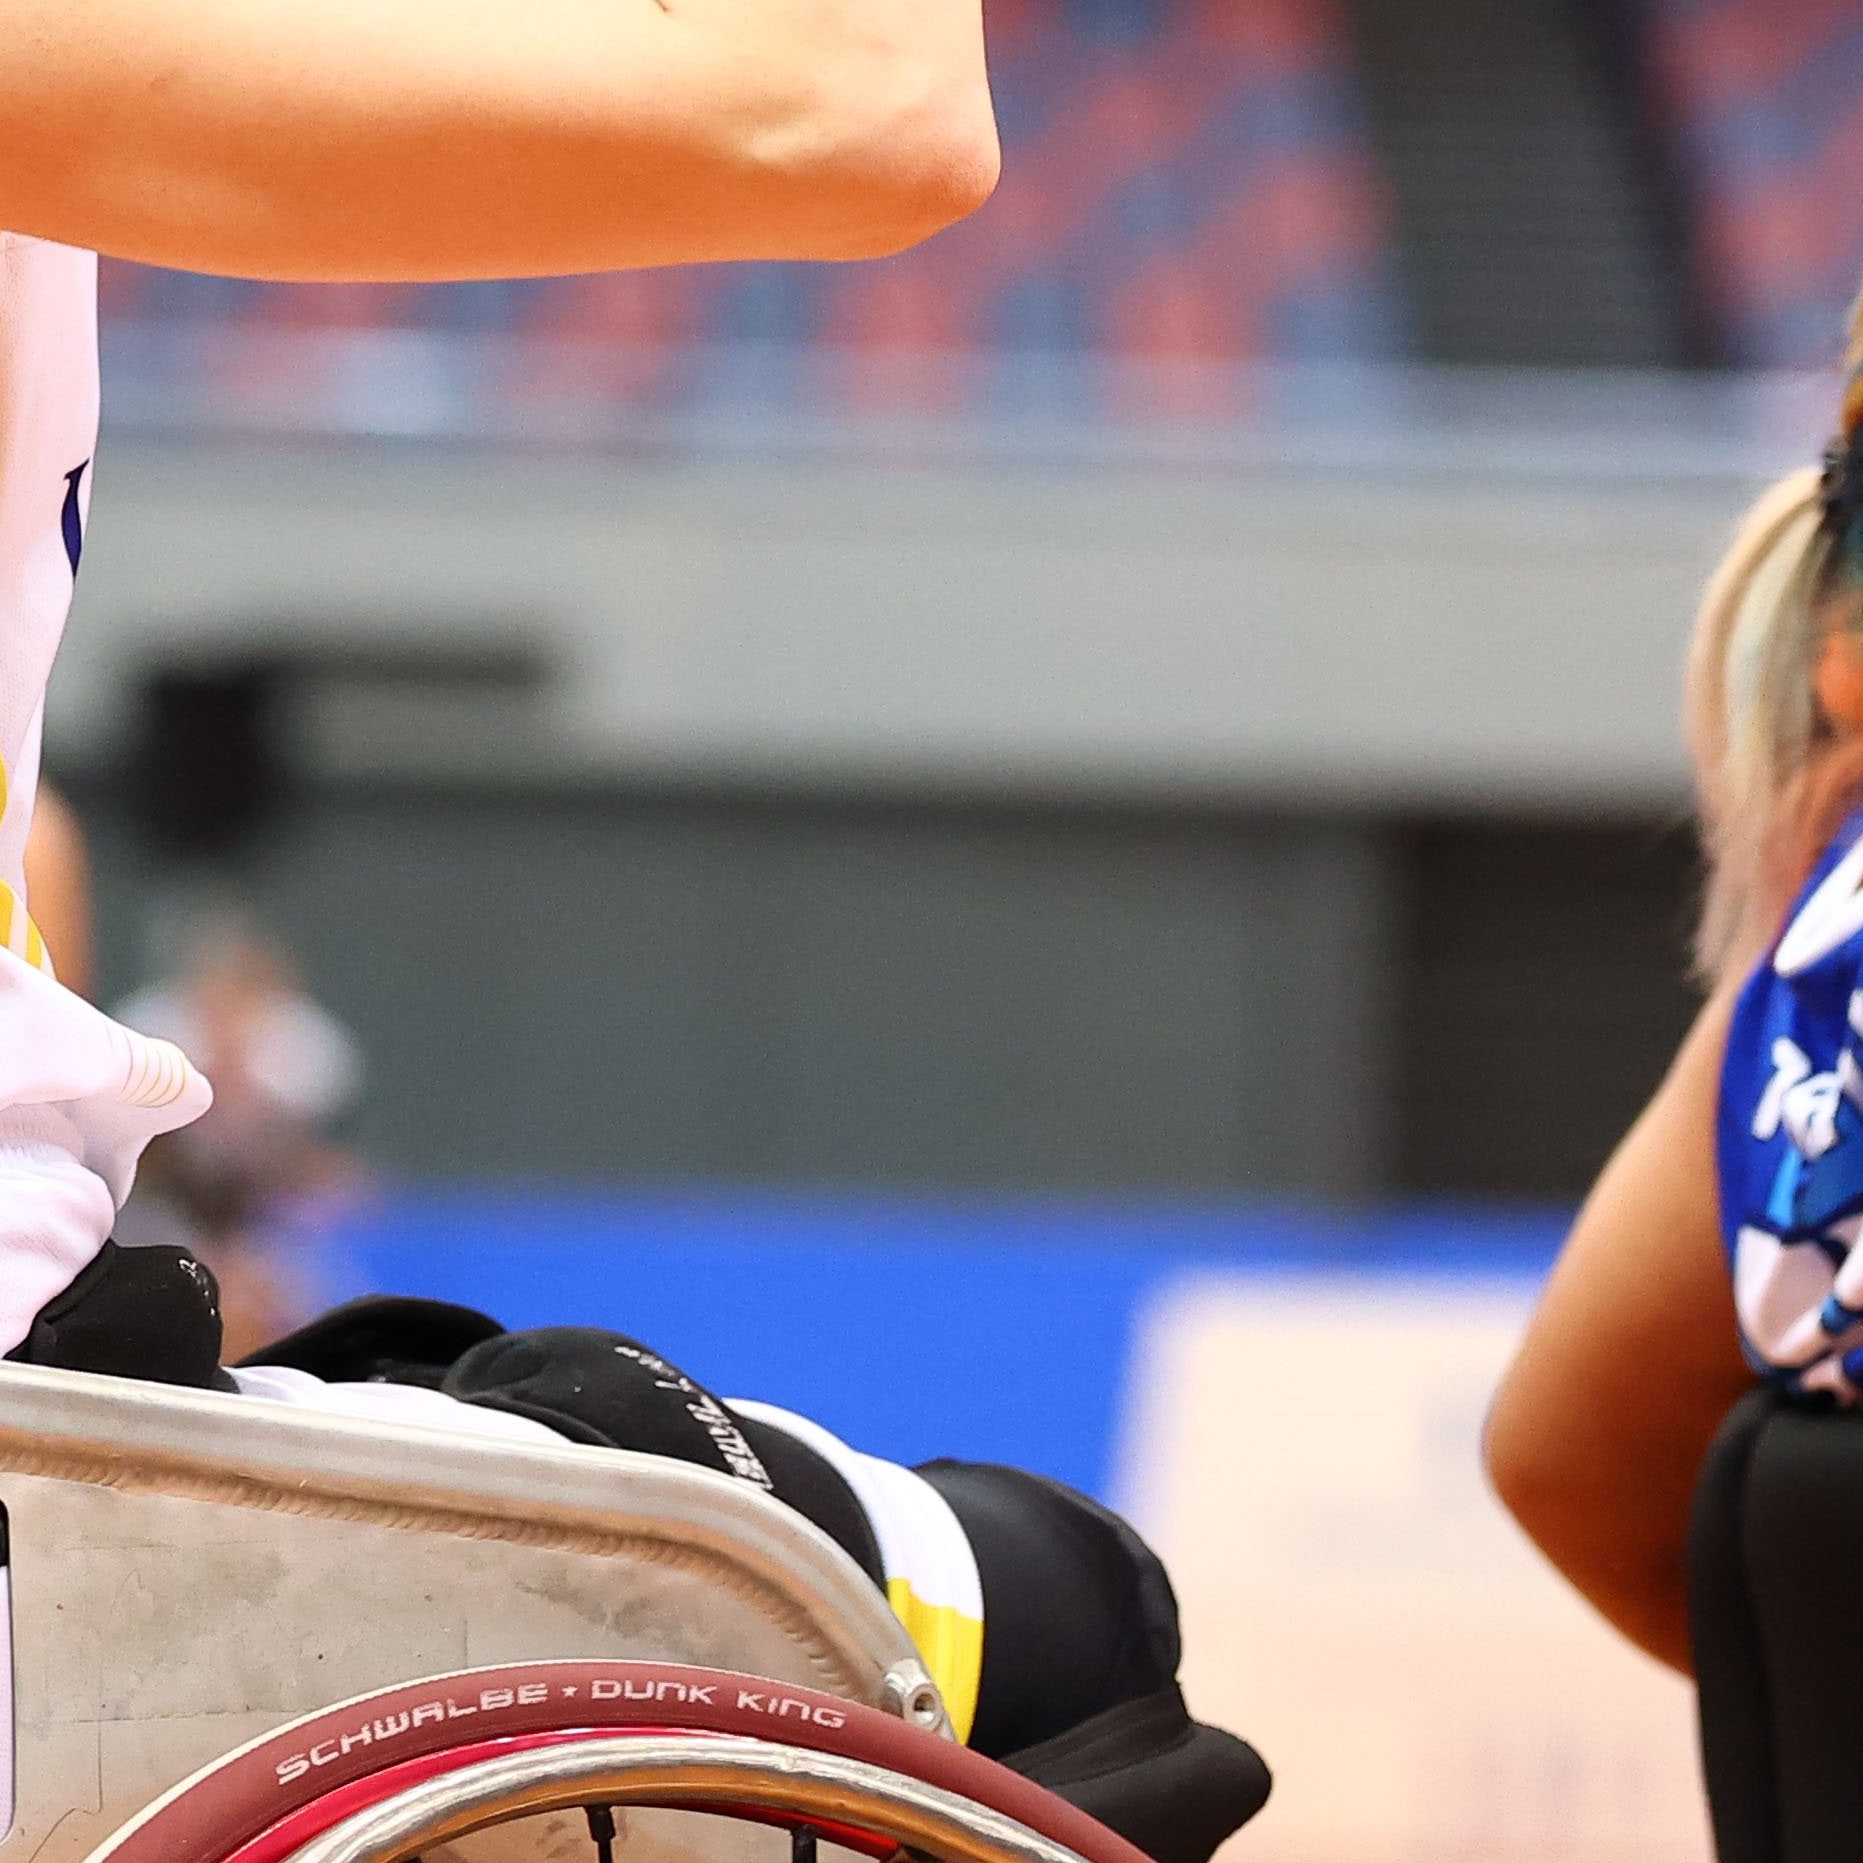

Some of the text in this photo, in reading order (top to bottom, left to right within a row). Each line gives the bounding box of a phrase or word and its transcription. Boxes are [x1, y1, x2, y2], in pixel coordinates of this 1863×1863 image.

[275, 1679, 847, 1786] SCHWALBE DUNK KING
